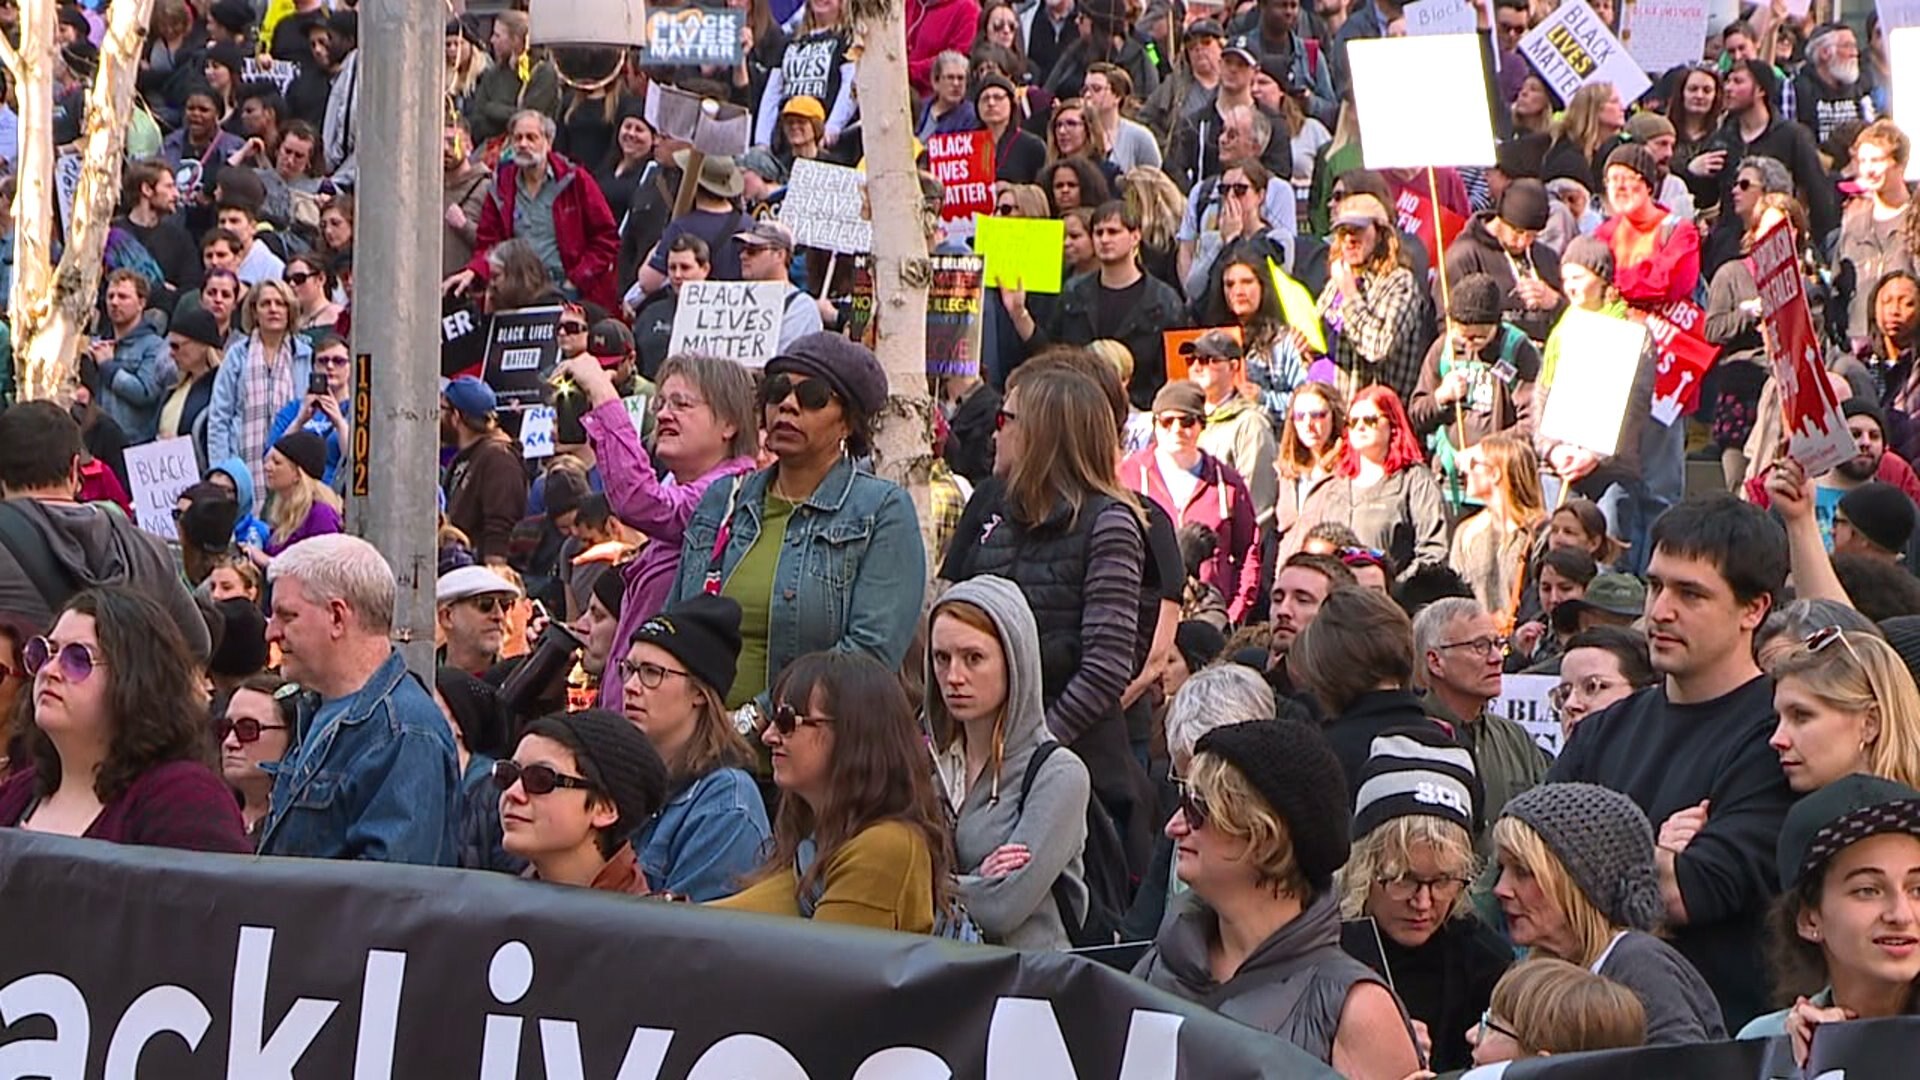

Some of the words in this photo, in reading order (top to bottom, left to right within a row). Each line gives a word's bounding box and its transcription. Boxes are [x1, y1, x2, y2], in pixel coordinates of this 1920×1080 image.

[653, 14, 736, 28] BLACK
[653, 27, 736, 44] LIVES
[1564, 5, 1615, 63] BLACK
[651, 44, 735, 59] MATTER
[1548, 25, 1592, 74] LIVES
[928, 134, 973, 158] BLACK
[930, 160, 968, 181] LIVES
[944, 182, 987, 205] ATTER
[1396, 190, 1419, 214] NO
[686, 284, 758, 306] BLACK
[696, 309, 773, 332] LIVES
[1661, 300, 1698, 330] OBS
[497, 327, 525, 342] BLACK
[528, 324, 553, 340] LIVES
[682, 334, 765, 358] MATTER
[355, 356, 369, 495] 1902
[136, 456, 189, 486] BLACK
[1508, 700, 1561, 722] BLA
